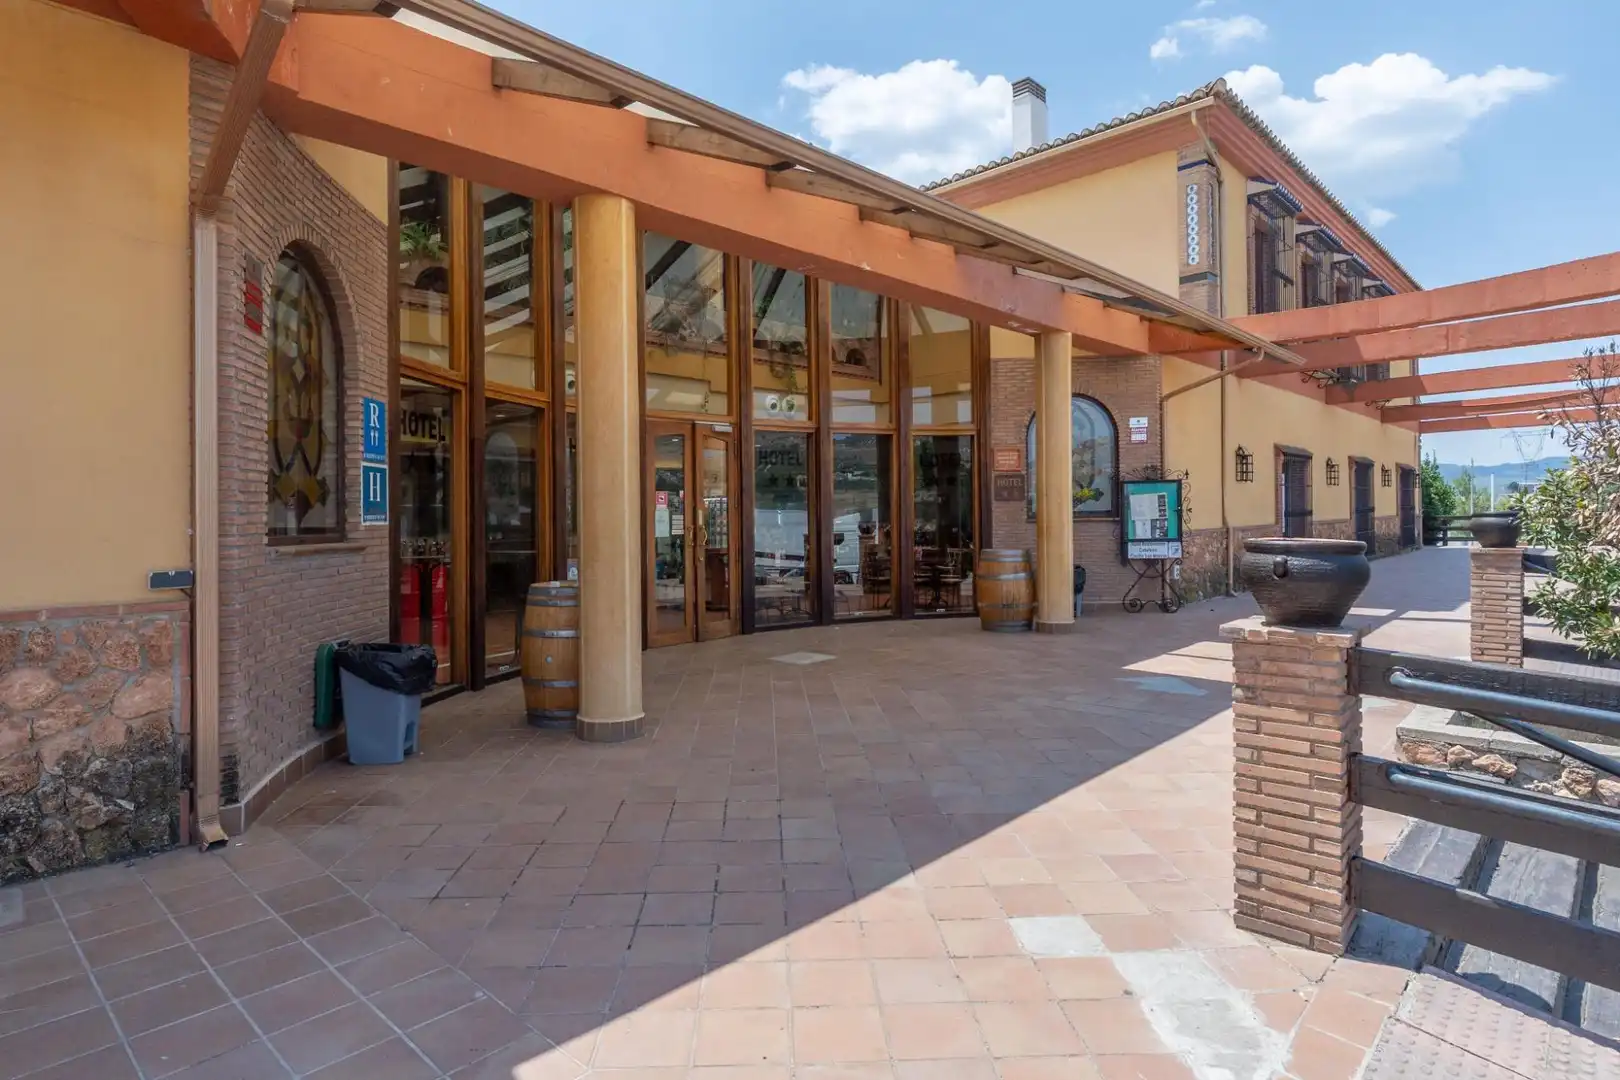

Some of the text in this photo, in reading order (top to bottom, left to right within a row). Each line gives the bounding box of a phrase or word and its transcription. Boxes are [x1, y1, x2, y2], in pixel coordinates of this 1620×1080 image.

[369, 403, 380, 428] R
[758, 449, 804, 466] HOTEL
[369, 472, 381, 501] H
[997, 478, 1024, 488] HOTEL
